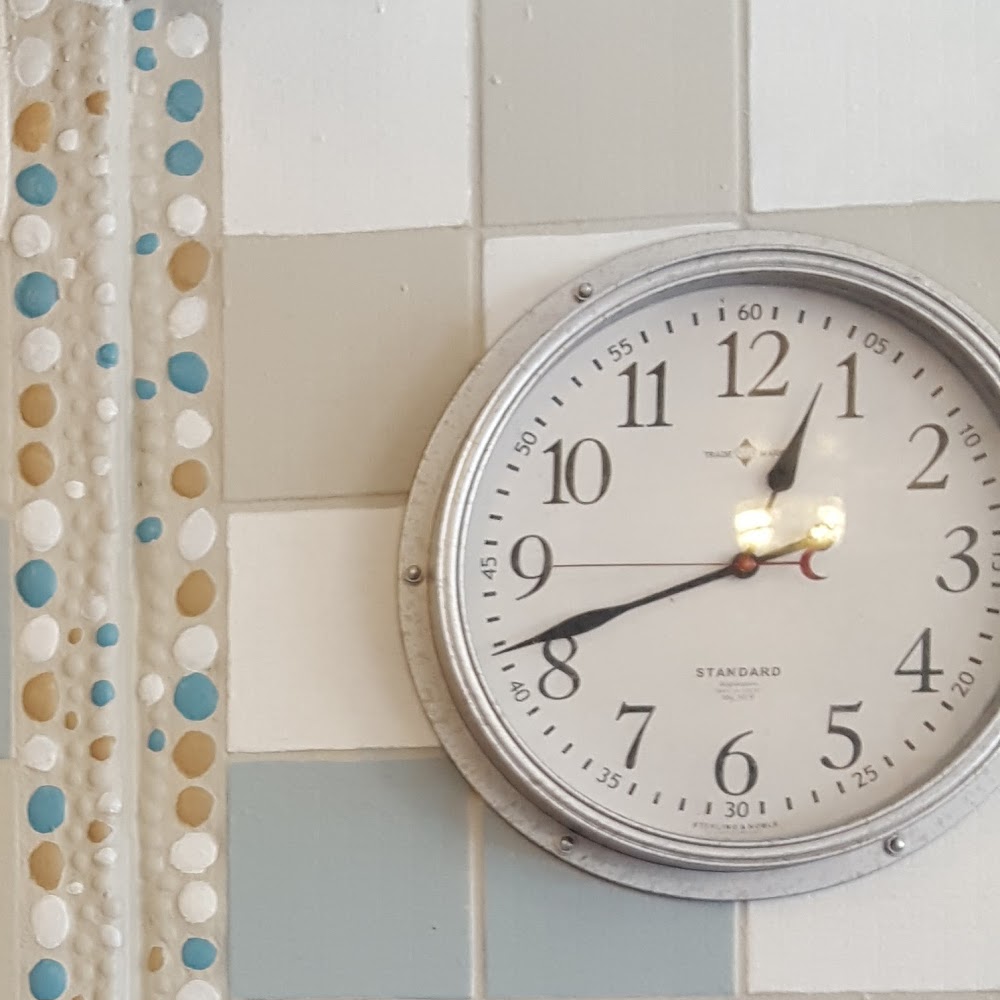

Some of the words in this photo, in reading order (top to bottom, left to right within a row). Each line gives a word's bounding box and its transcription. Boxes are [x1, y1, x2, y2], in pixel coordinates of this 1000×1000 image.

[737, 304, 763, 320] 60
[607, 339, 634, 362] 55
[717, 330, 790, 398] 12
[863, 332, 889, 355] 05
[617, 361, 673, 428] 11
[836, 352, 865, 418] 1
[513, 431, 538, 456] 50
[906, 423, 949, 490] 2
[959, 423, 981, 448] 10
[542, 437, 613, 505] 10
[480, 556, 498, 580] 45
[510, 534, 553, 600] 9
[935, 525, 980, 593] 3
[538, 636, 581, 700] 8
[695, 666, 781, 678] STANDARD
[894, 626, 944, 693] 4
[510, 680, 531, 702] 40
[951, 671, 975, 698] 20
[615, 701, 656, 769] 7
[820, 701, 863, 770] 5
[596, 766, 622, 789] 35
[714, 730, 758, 796] 6
[851, 764, 879, 788] 25
[724, 801, 750, 817] 30
